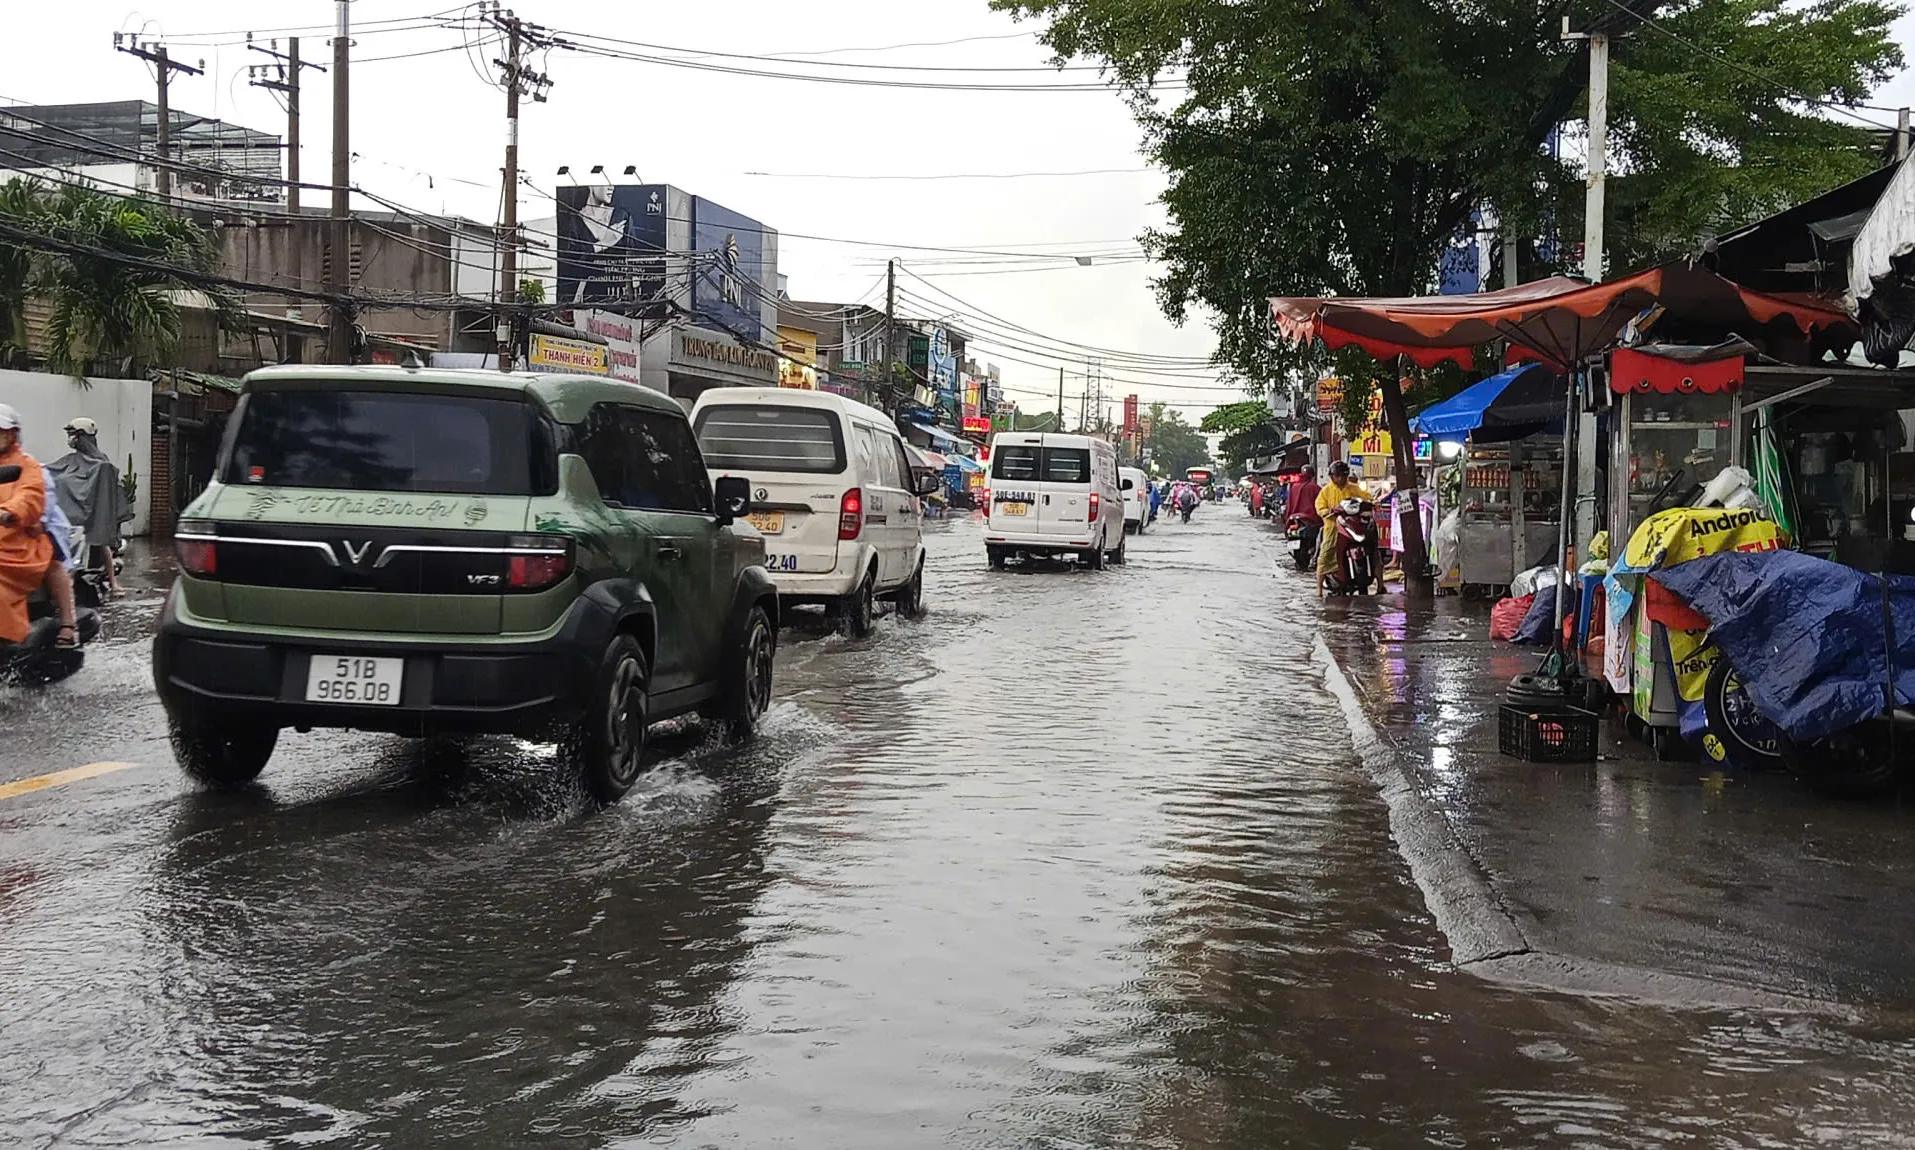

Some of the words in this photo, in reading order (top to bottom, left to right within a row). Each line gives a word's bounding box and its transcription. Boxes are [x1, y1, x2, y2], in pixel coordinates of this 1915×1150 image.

[647, 203, 662, 213] PNJ
[720, 274, 742, 308] PNJ
[543, 349, 571, 363] THANH
[593, 357, 599, 367] 2
[336, 658, 376, 679] 51B
[1675, 658, 1707, 676] Trên
[317, 680, 390, 701] 966.08
